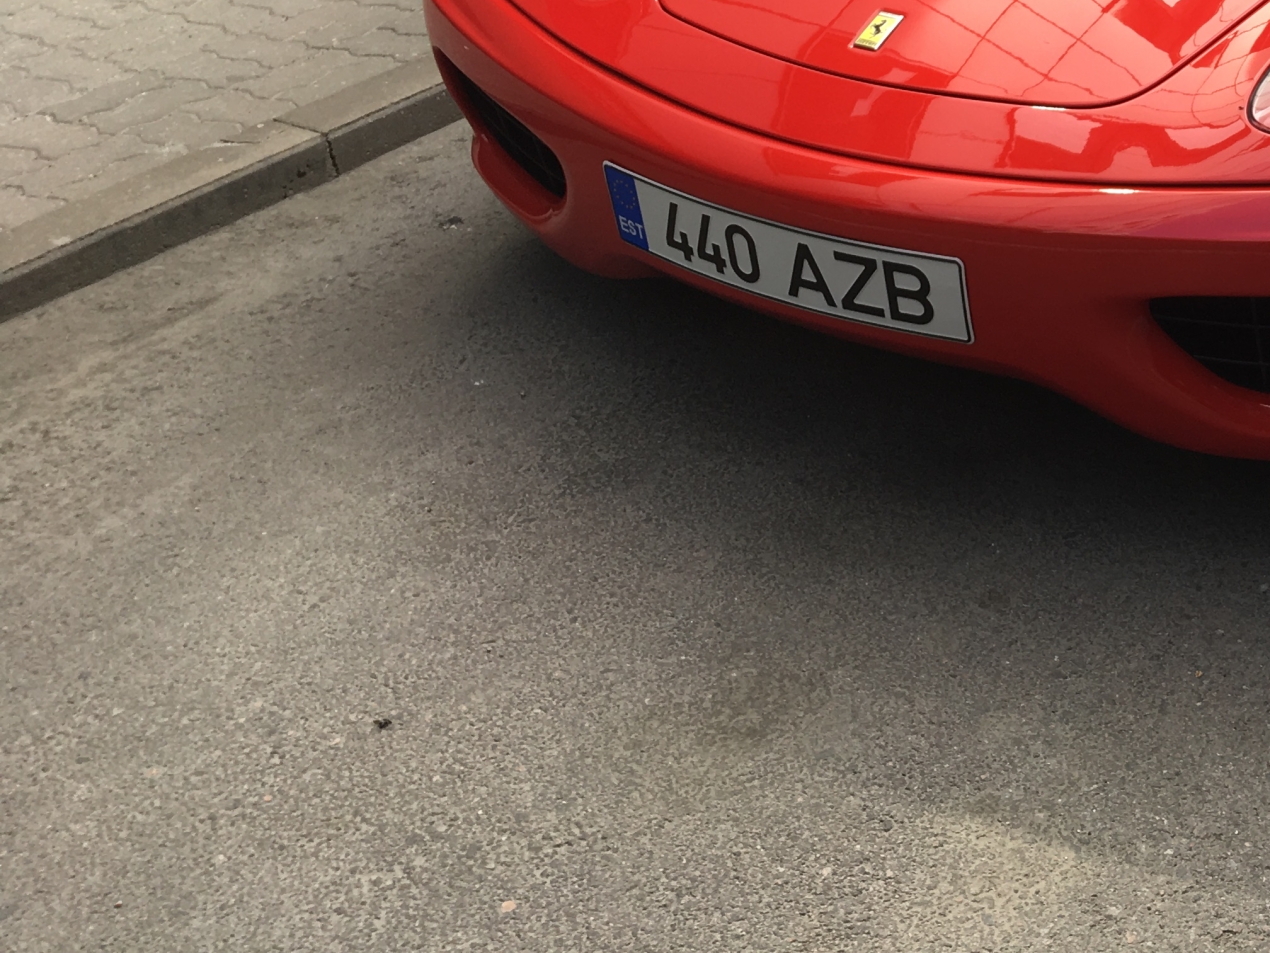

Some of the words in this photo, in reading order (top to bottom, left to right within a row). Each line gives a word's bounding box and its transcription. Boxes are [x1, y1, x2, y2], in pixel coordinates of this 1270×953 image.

[619, 215, 644, 239] EST
[666, 201, 760, 284] 440
[788, 242, 934, 325] AZB
